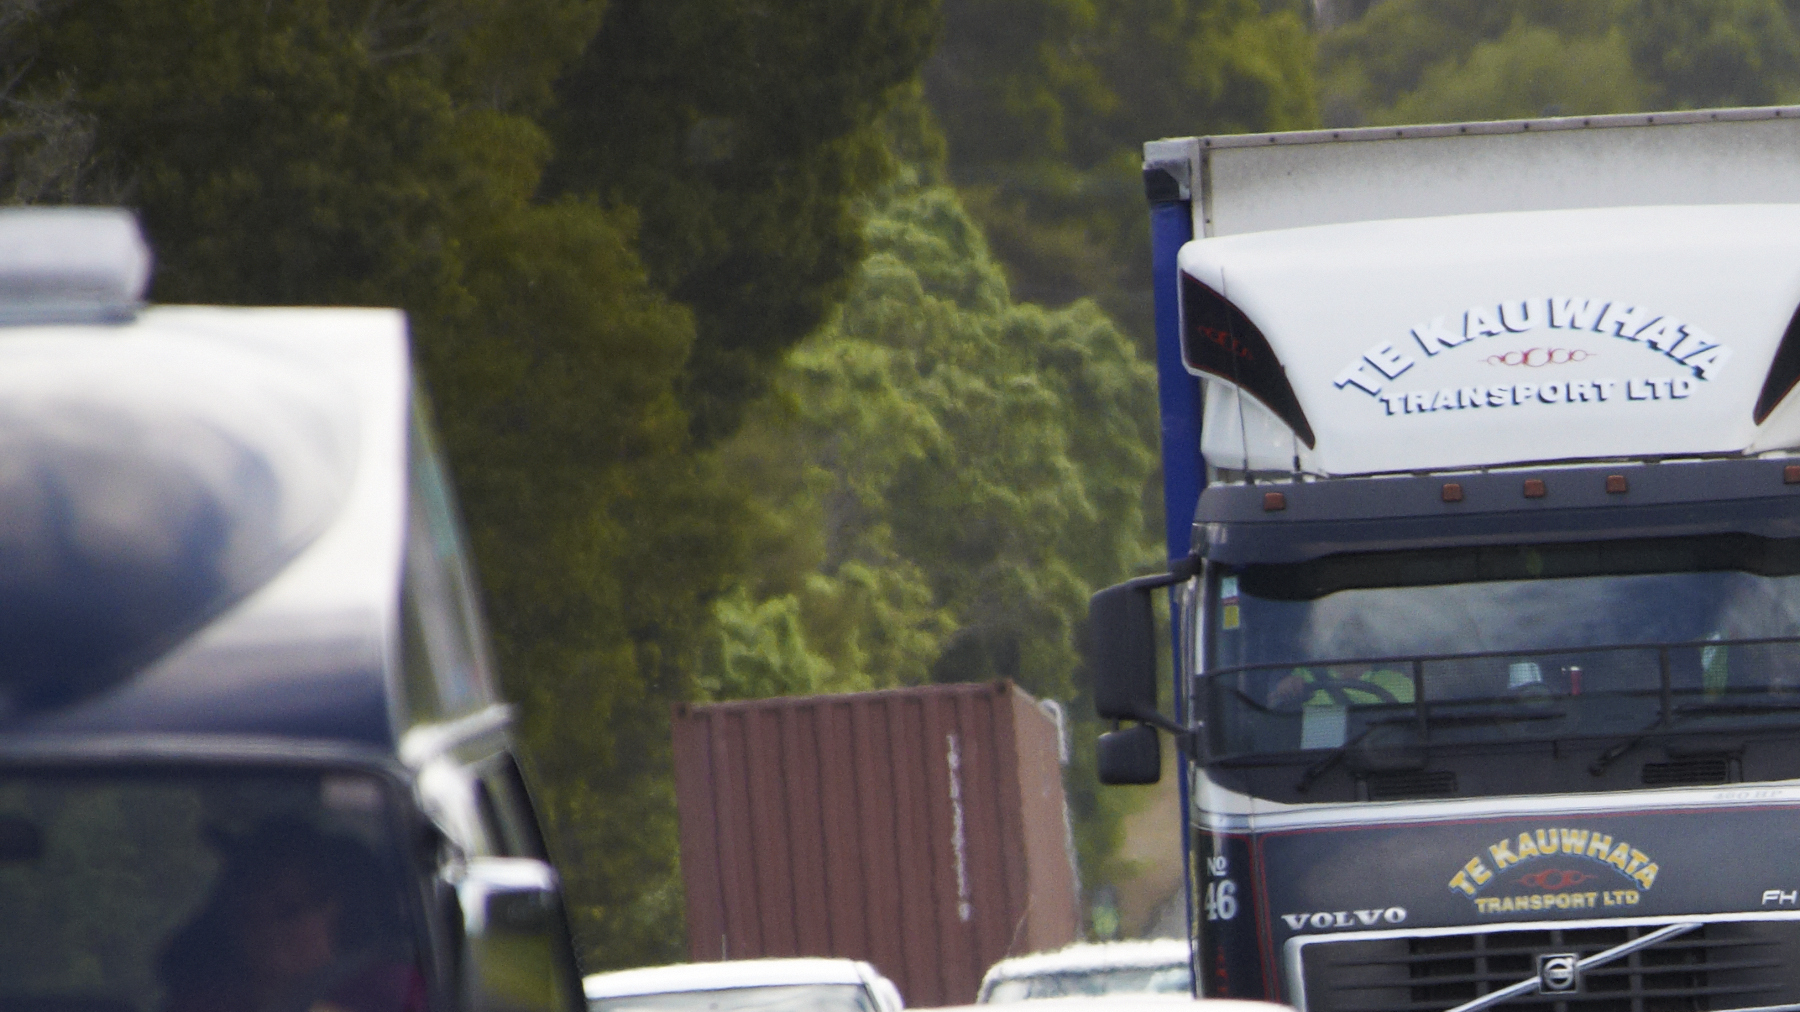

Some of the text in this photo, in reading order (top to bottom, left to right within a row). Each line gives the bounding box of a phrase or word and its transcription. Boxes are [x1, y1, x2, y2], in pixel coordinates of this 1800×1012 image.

[1333, 297, 1733, 397] TE KAUWHATA
[1379, 375, 1699, 415] TRANSPORT LTD
[1448, 828, 1659, 897] TE KAUWHATA
[1204, 879, 1237, 921] 46
[1281, 906, 1407, 931] VOLVO
[1474, 889, 1640, 914] TRANSPORT LTD
